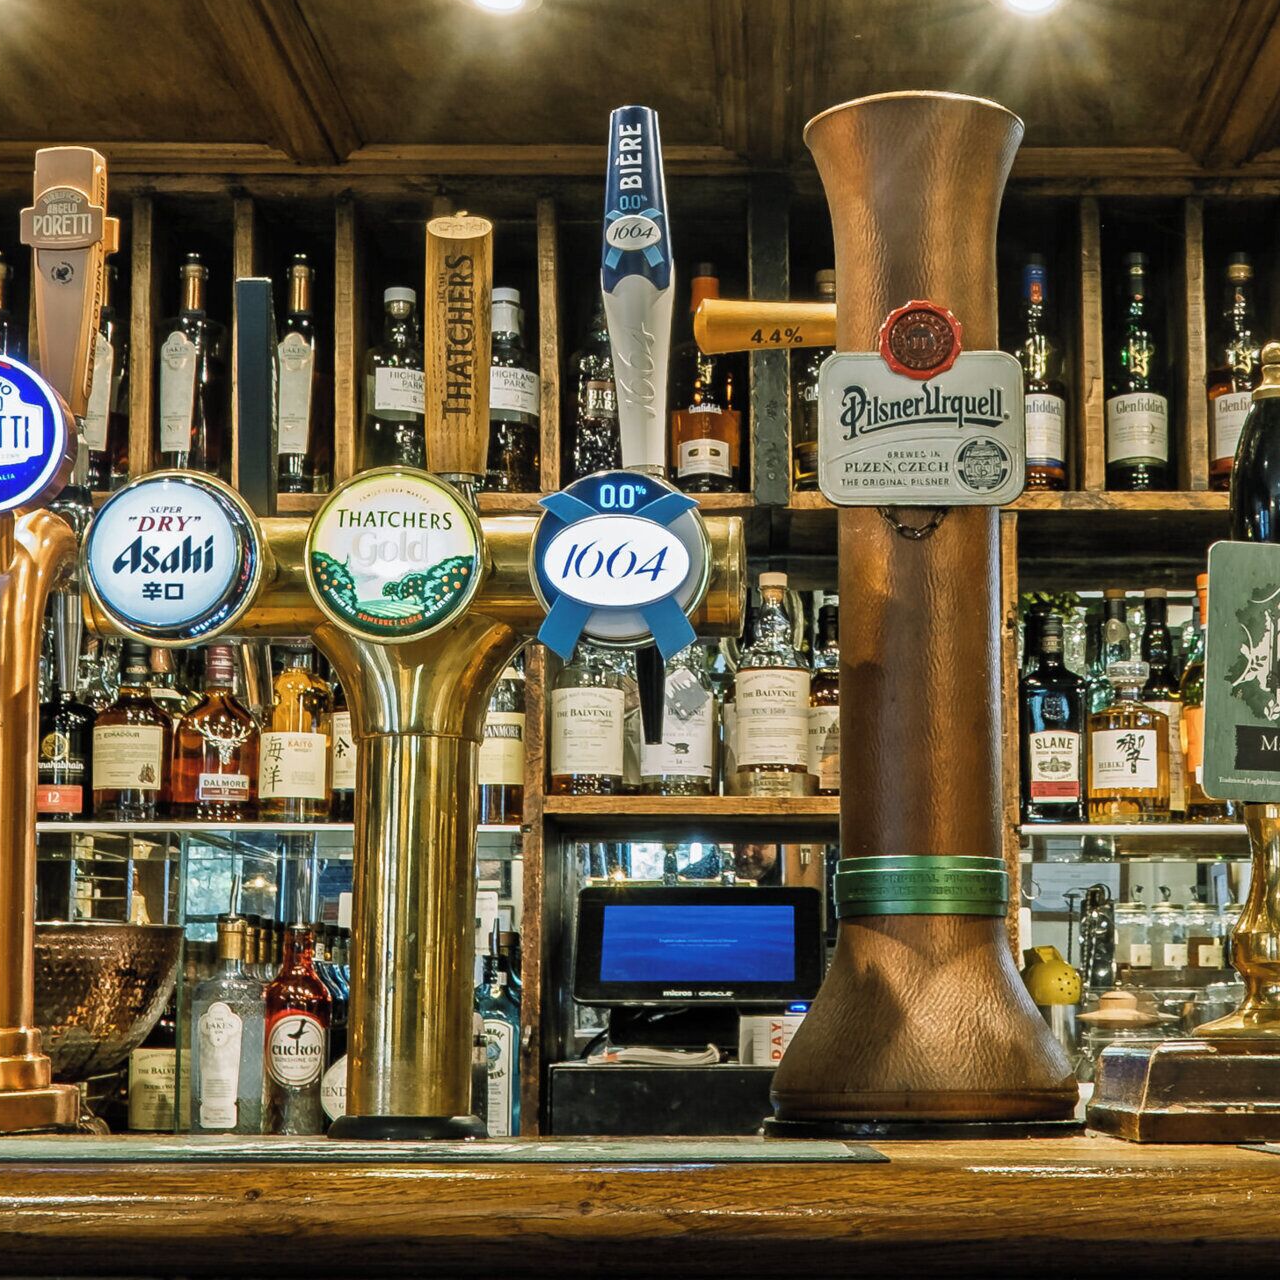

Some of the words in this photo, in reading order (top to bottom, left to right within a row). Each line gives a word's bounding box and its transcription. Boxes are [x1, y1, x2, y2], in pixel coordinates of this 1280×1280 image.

[615, 123, 642, 190] BIÈRE
[33, 213, 91, 236] PORETTI
[613, 222, 655, 241] 1664
[442, 253, 474, 420] THATCHERS
[751, 326, 803, 344] 4.4%
[503, 380, 527, 389] PARK
[840, 384, 924, 442] Pilsner
[922, 382, 1003, 428] Urquell
[898, 461, 950, 473] CZECH
[841, 478, 859, 487] THE
[862, 477, 907, 486] ORIGINAL
[911, 477, 950, 486] PILSNER
[599, 484, 646, 509] 0.0%
[338, 508, 452, 530] THATCHERS
[113, 535, 214, 574] Asahi
[352, 531, 429, 568] Gold
[142, 581, 184, 601] 辛口
[1035, 737, 1074, 750] SLANE
[204, 779, 247, 788] DALMORE
[47, 791, 60, 804] 12
[272, 1040, 321, 1057] cuckoo
[770, 1022, 783, 1060] DAY
